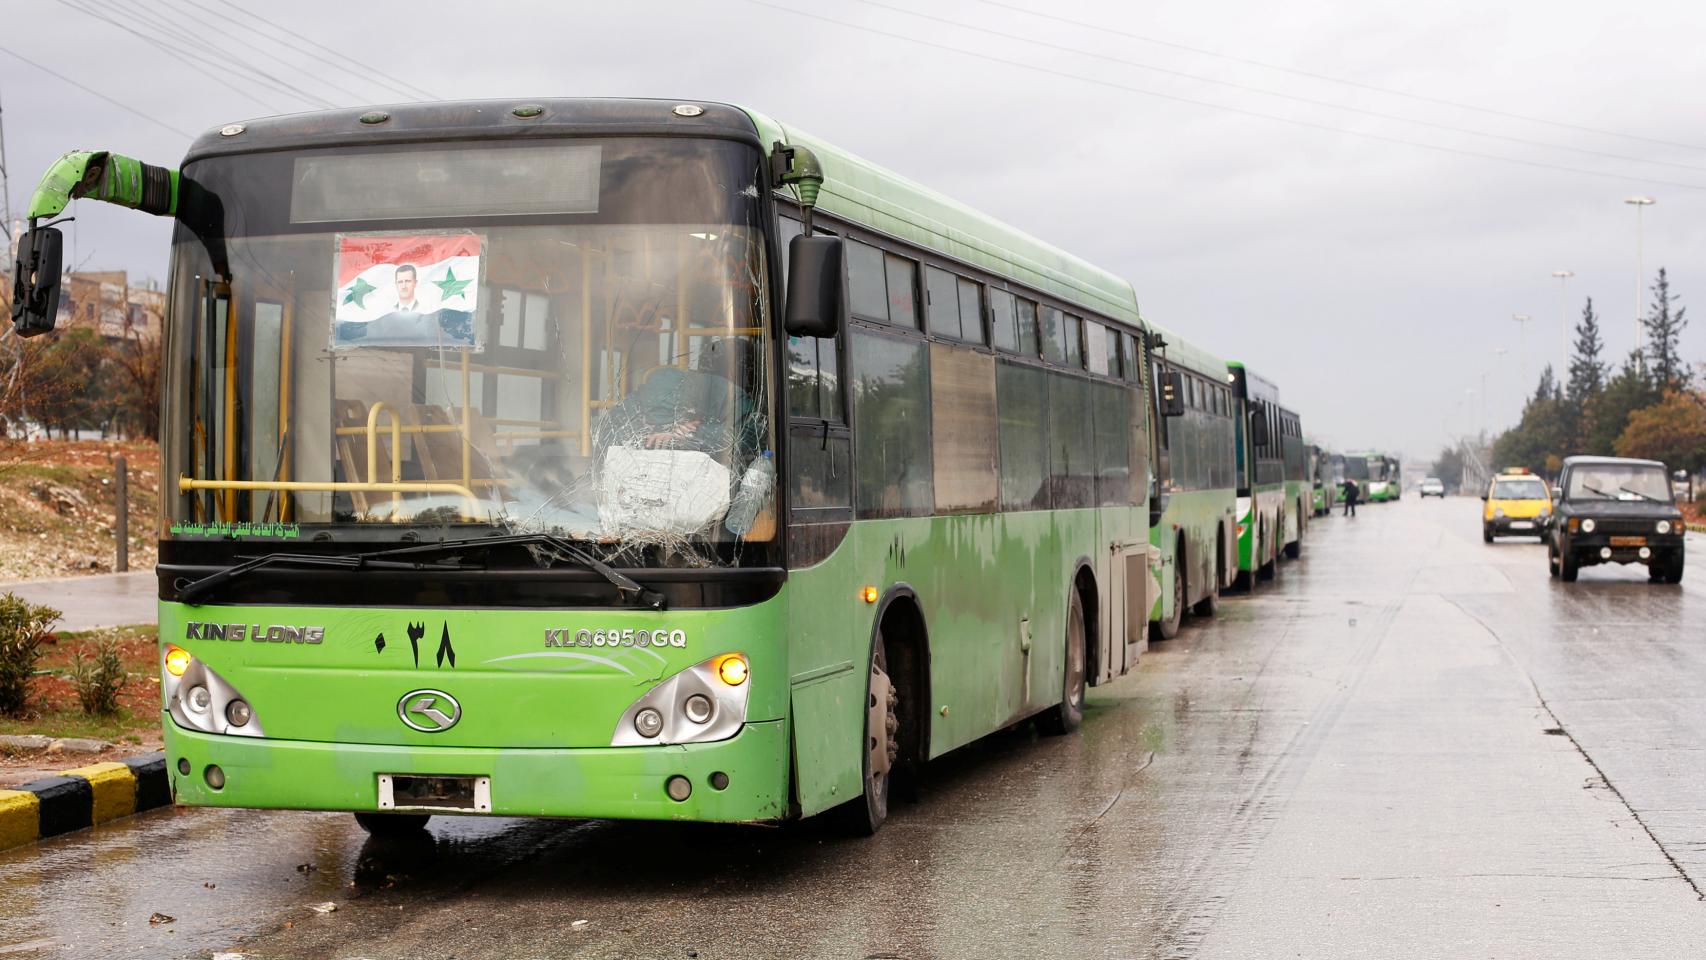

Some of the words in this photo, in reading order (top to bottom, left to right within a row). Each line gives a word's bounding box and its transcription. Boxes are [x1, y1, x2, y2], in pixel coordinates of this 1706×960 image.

[186, 621, 247, 641] KING
[251, 624, 325, 645] LONG
[544, 628, 687, 649] KLQ6950GQ
